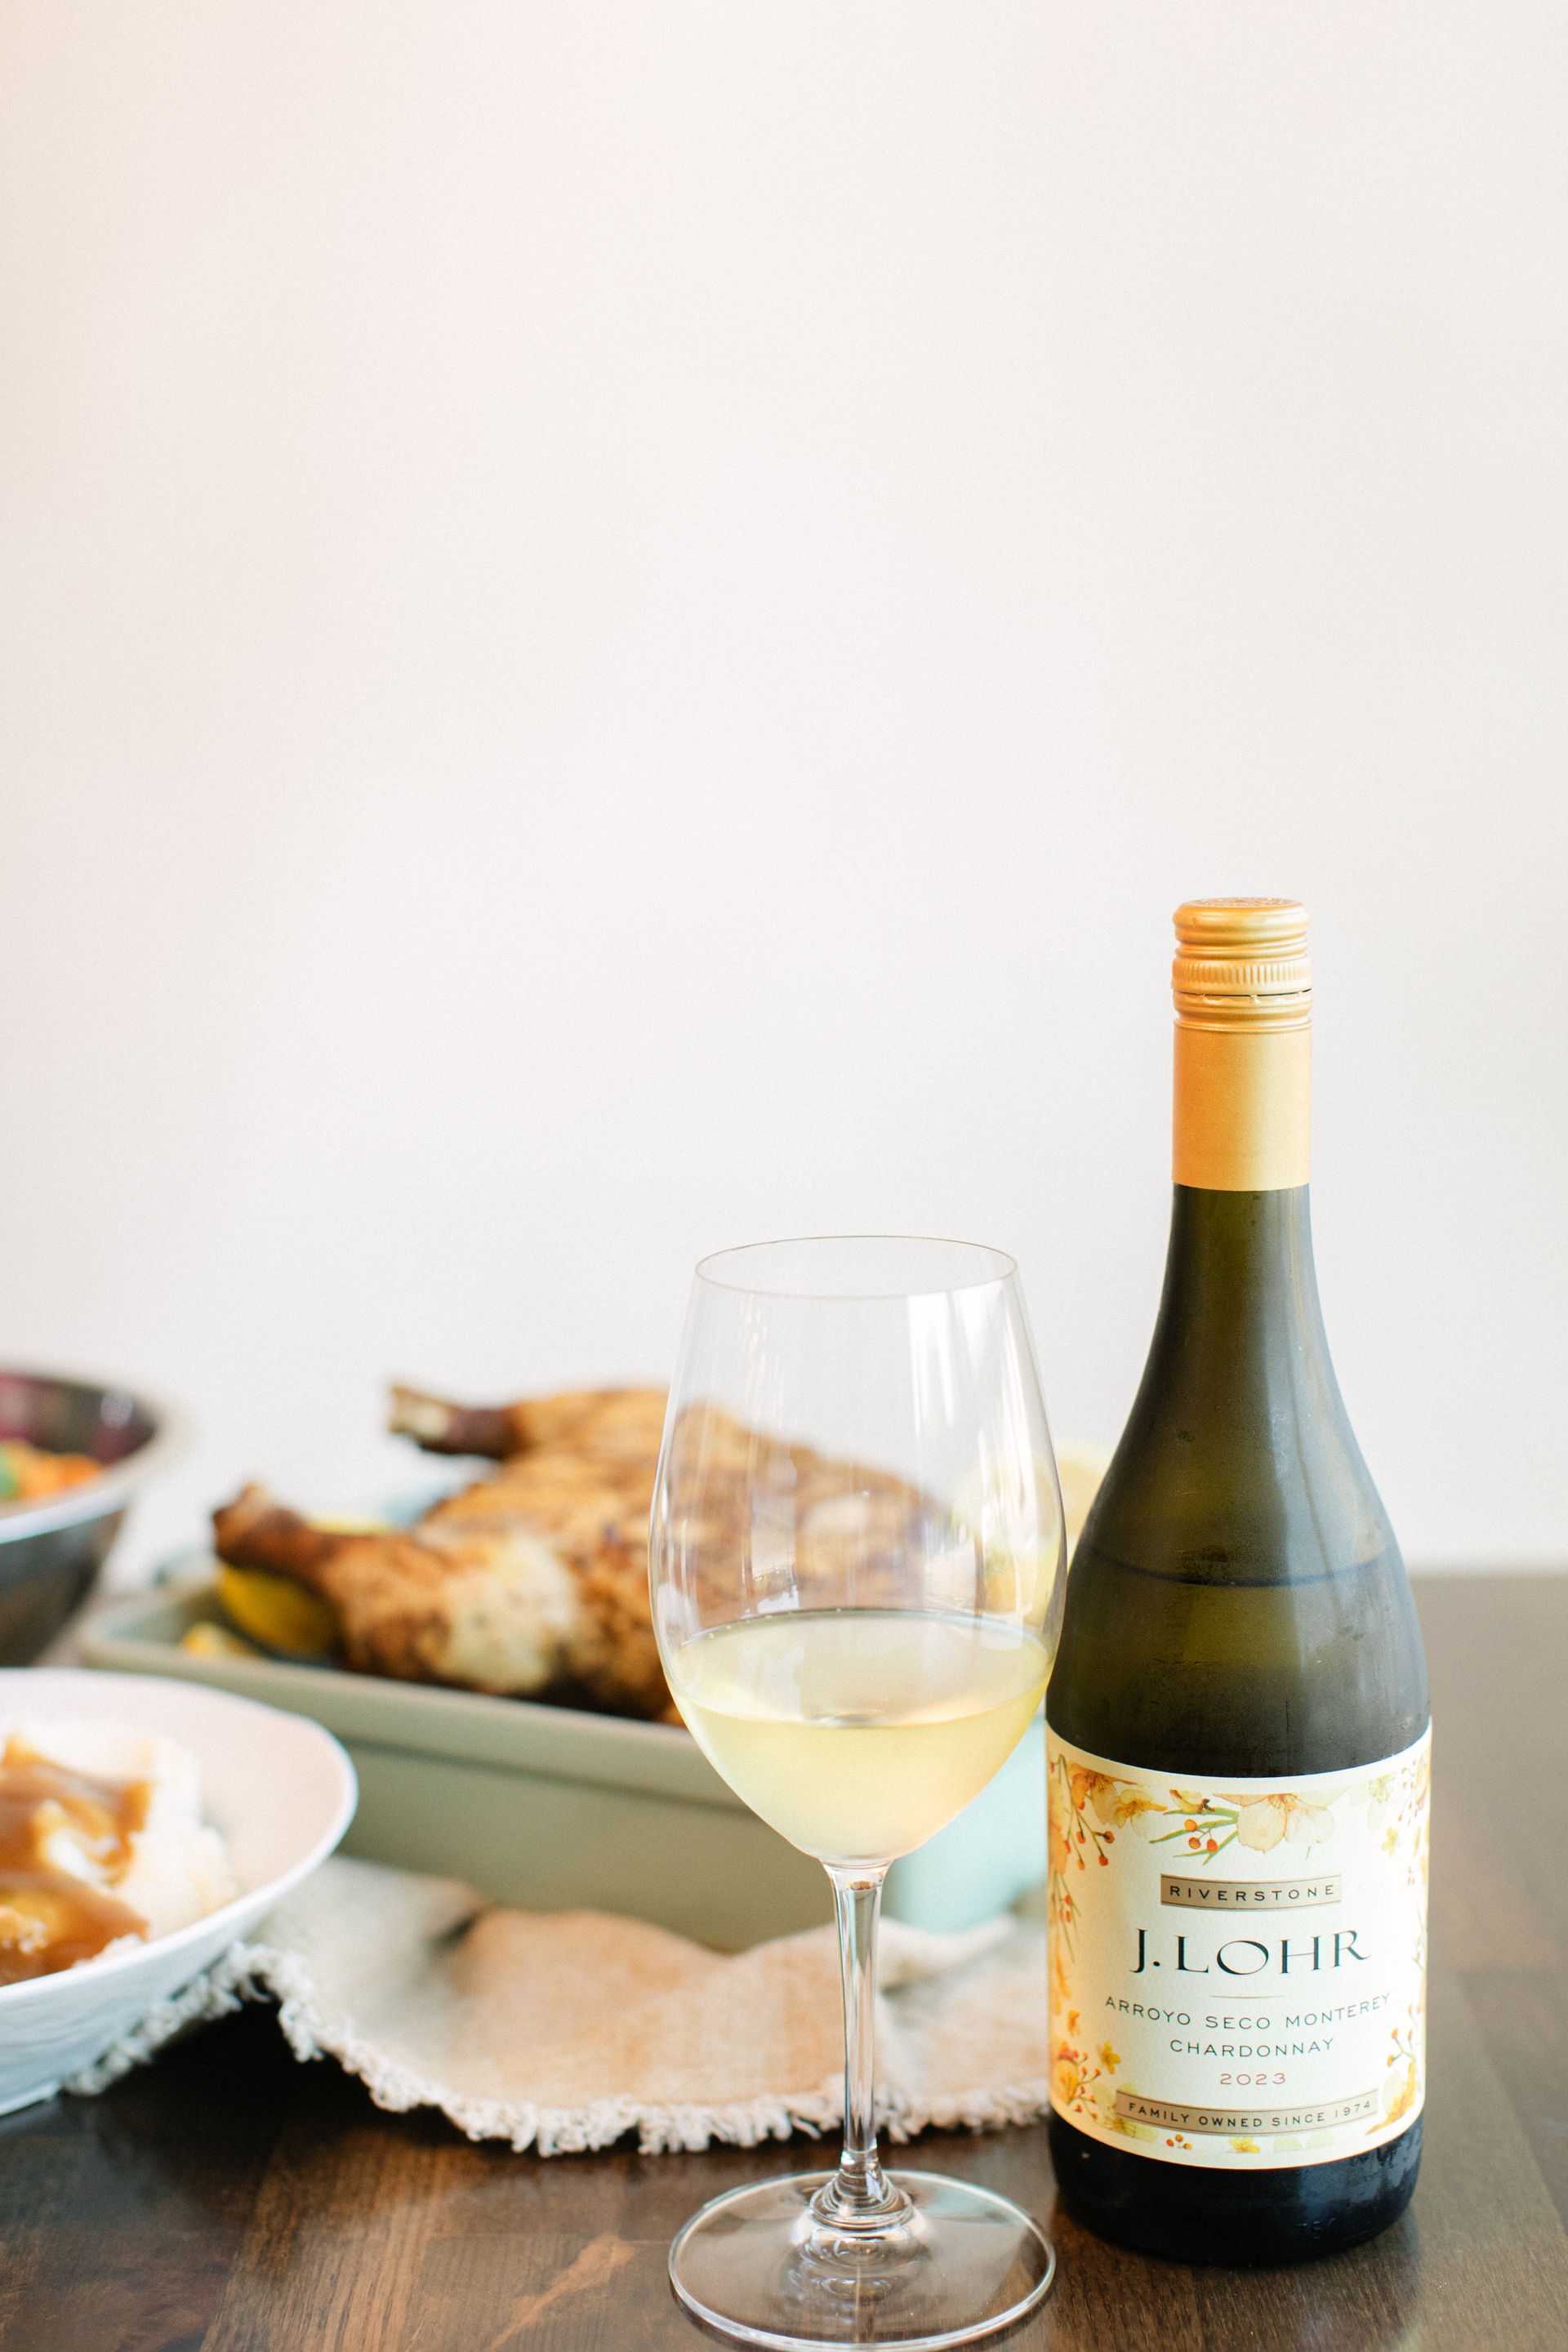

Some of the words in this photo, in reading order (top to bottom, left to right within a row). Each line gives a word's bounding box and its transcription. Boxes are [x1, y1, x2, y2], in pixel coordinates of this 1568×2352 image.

[1169, 1884, 1334, 1902] RIVERSTONE
[1105, 1997, 1192, 2025] ARROYO
[1205, 2016, 1271, 2030] SECO
[1285, 1993, 1391, 2029] MONTEREY
[1169, 2038, 1334, 2057] CHARDONNAY
[1219, 2073, 1286, 2086] 2023
[1129, 2102, 1190, 2124] FAMILY
[1198, 2115, 1263, 2127] OWNED
[1272, 2112, 1325, 2127] SINCE
[1334, 2100, 1371, 2119] 1974
